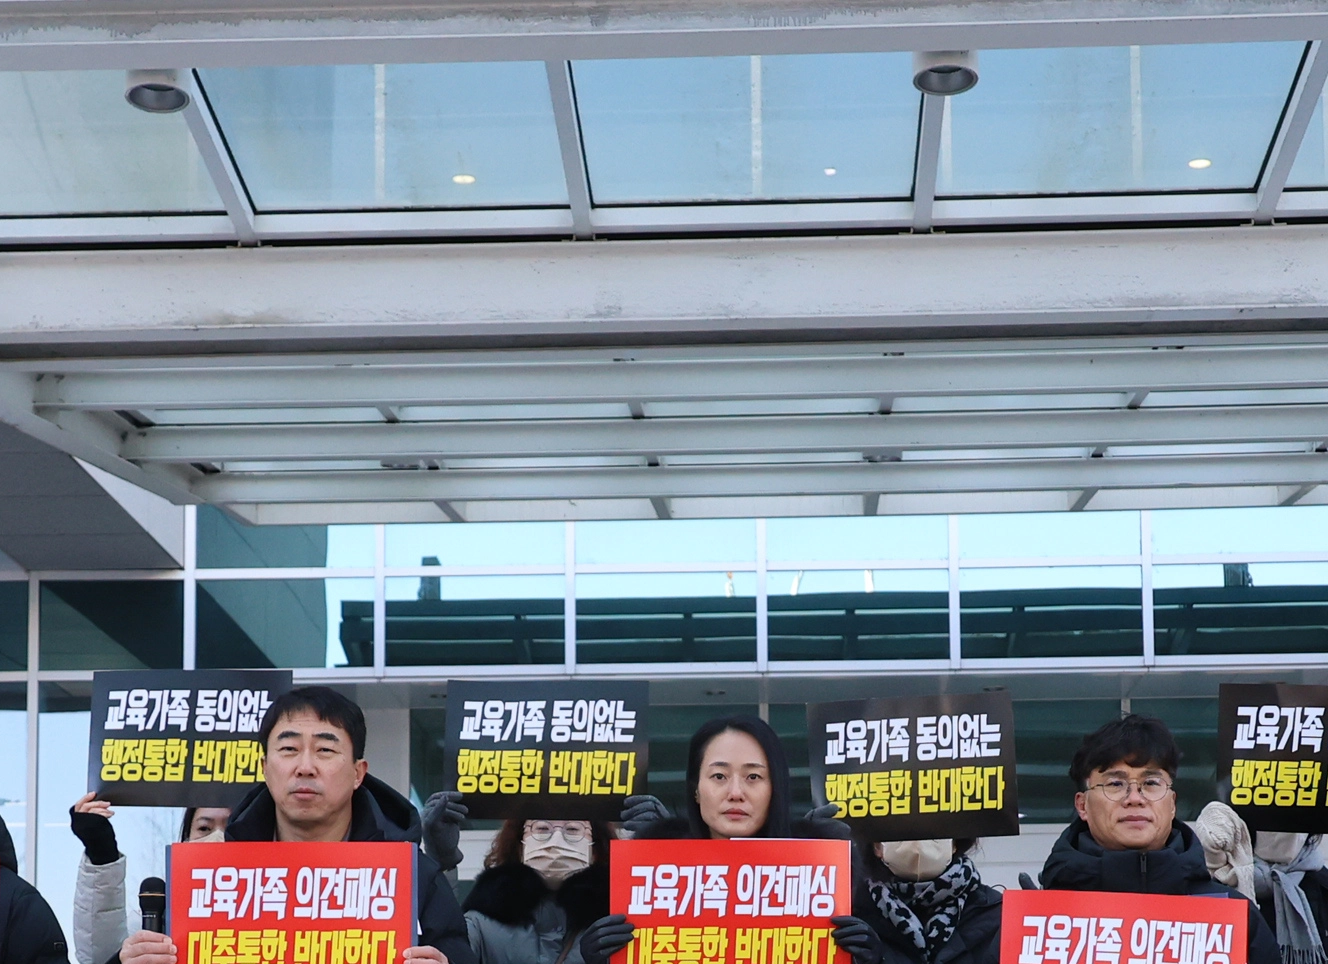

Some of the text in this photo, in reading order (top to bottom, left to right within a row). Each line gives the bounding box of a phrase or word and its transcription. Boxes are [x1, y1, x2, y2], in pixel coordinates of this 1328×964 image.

[105, 689, 190, 731] 교육가족
[460, 700, 636, 742] 교육가족 동의없는
[1234, 706, 1324, 752] 교육가족
[101, 739, 188, 781] 행정통합
[825, 714, 1001, 764] 교육가족 동의없는
[458, 749, 636, 795] 행정통합 반대한다
[826, 766, 1004, 817] 행정통합 반대한다
[1231, 760, 1321, 806] 행정통합
[189, 867, 397, 920] 교육가족 의견패싱
[629, 865, 836, 917] 교육가족 의견패싱
